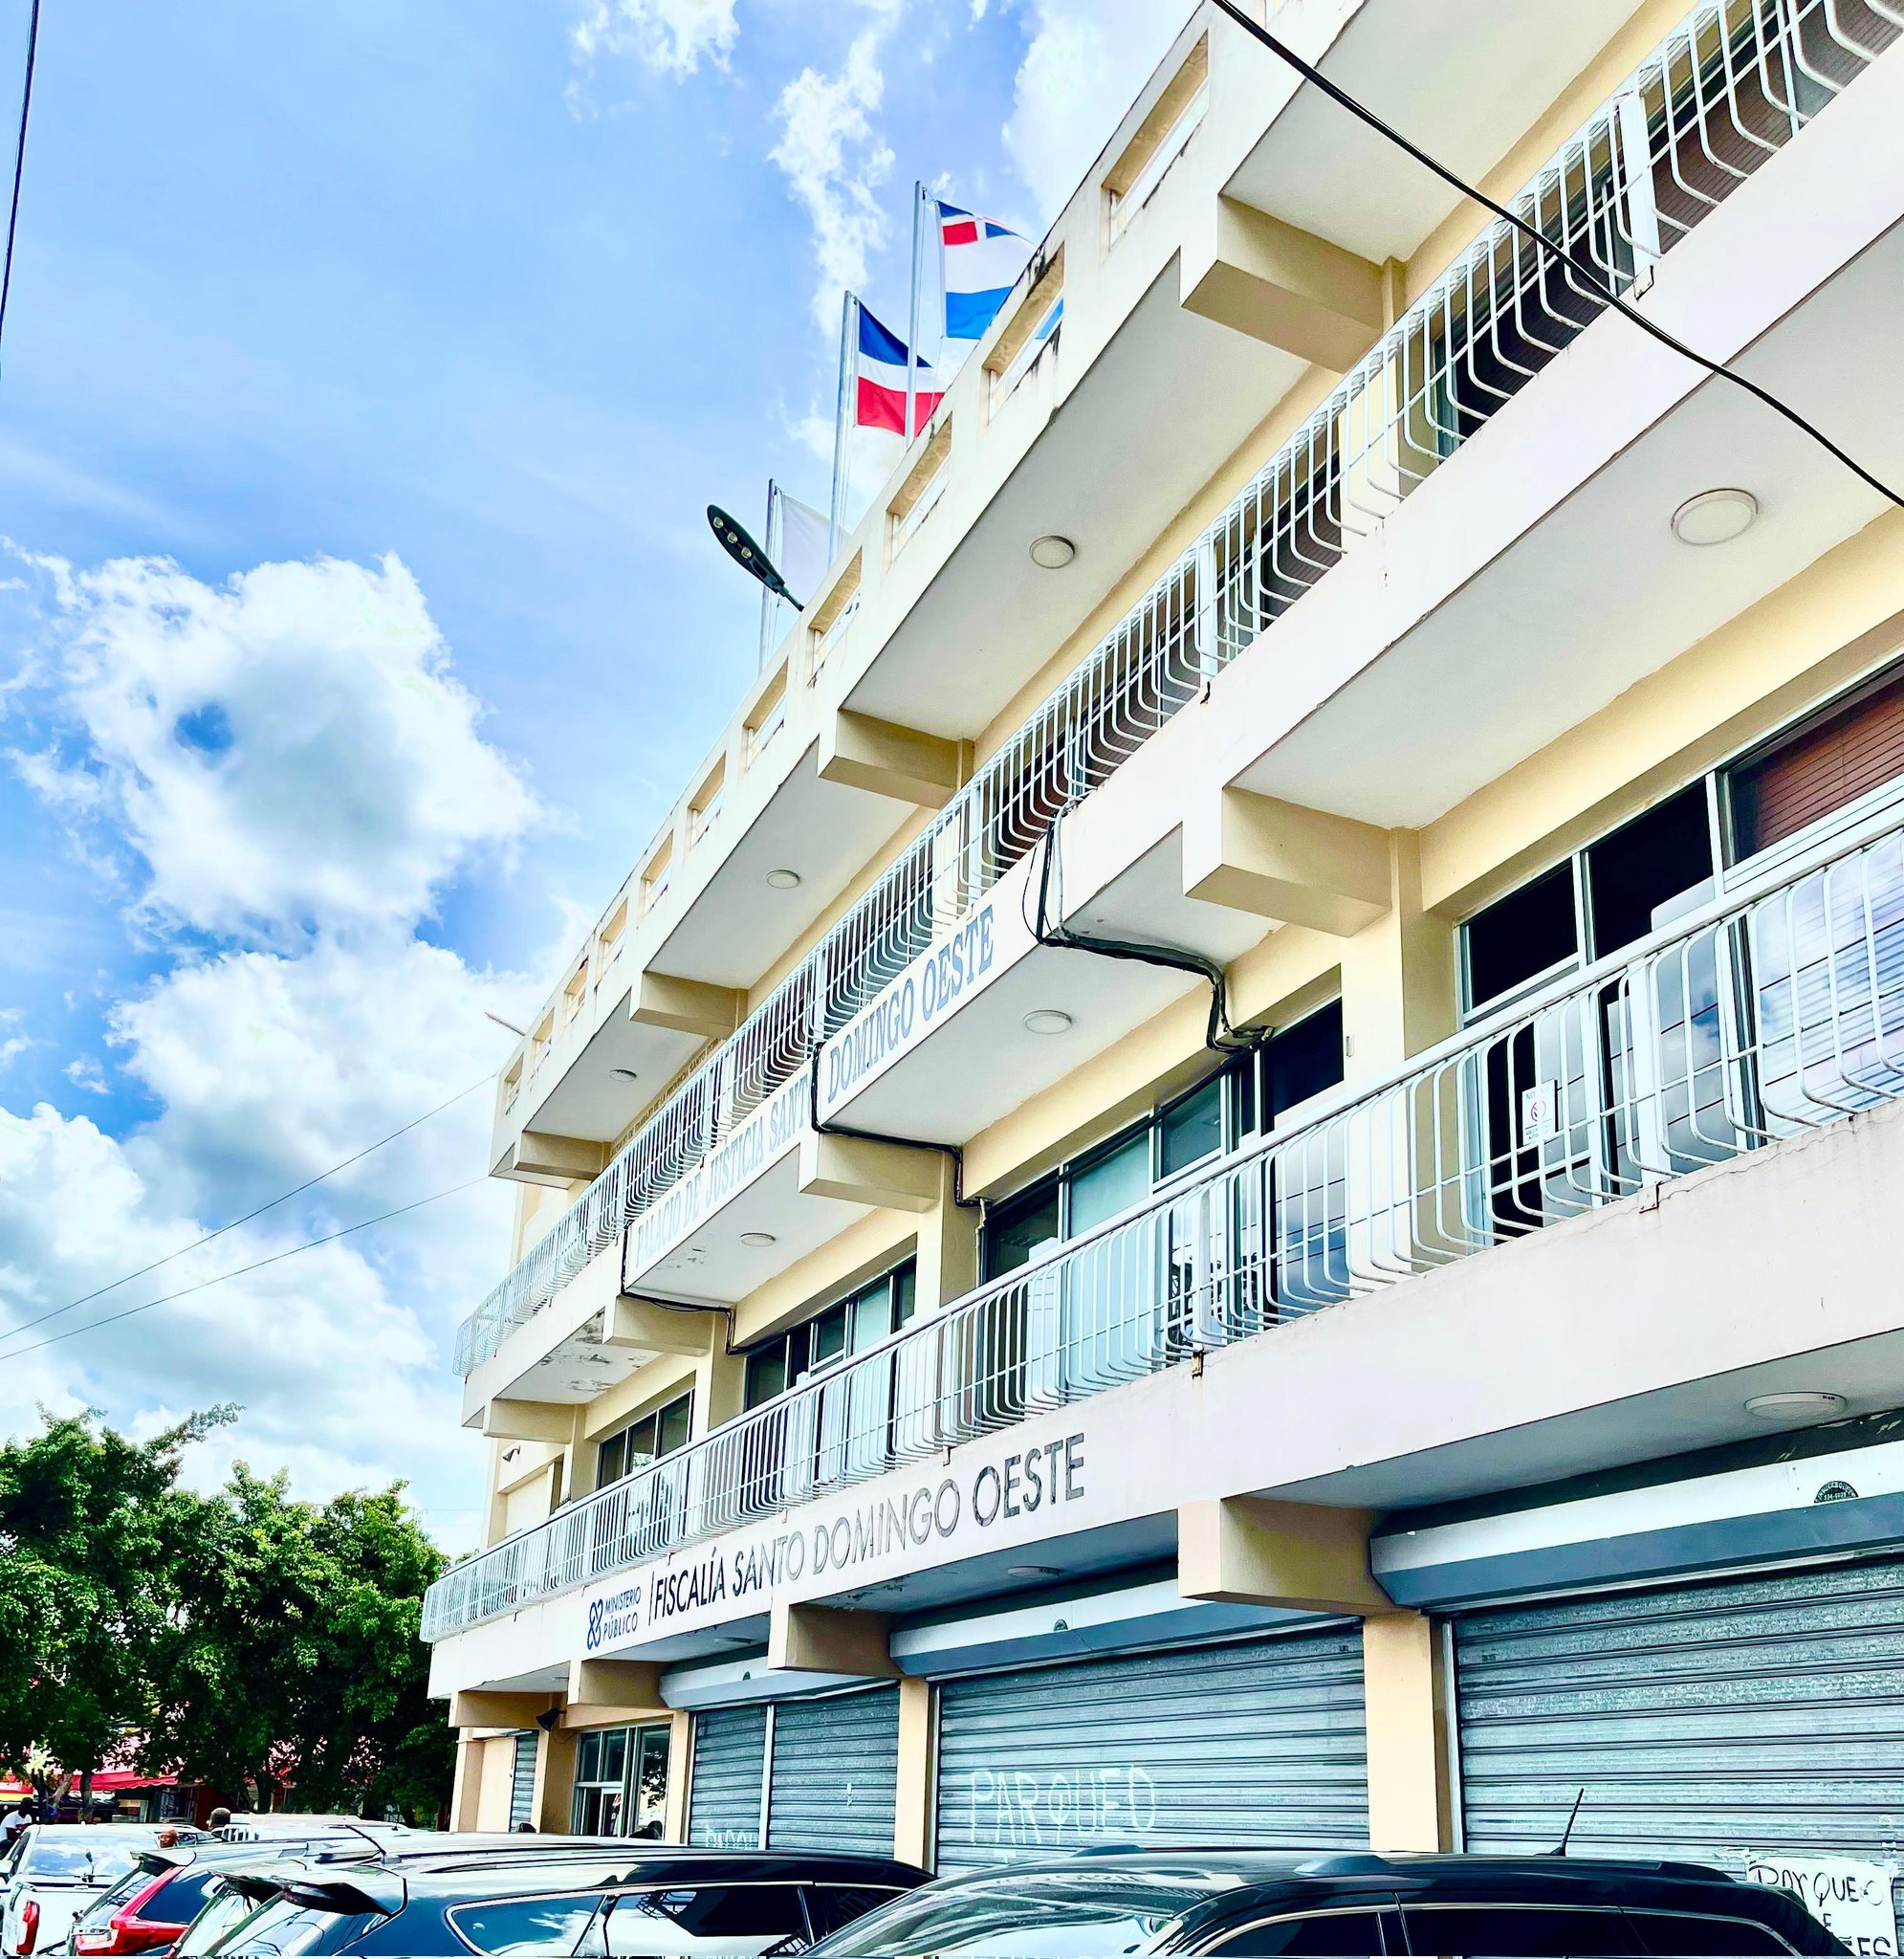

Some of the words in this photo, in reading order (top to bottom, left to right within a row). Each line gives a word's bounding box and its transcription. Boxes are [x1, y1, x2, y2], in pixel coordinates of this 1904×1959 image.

[684, 1173, 701, 1230] DE
[707, 1115, 764, 1209] JUSTICIA
[828, 977, 914, 1104] DOMINGO
[922, 904, 994, 1022] OESTE
[689, 1050, 706, 1072] SANTO
[654, 1547, 726, 1619] FISCALÍA
[733, 1530, 804, 1597] SANTO
[813, 1478, 961, 1575] DOMINGO
[972, 1433, 1084, 1528] OESTE
[603, 1612, 639, 1641] PÚBLICO
[604, 1586, 642, 1617] MINISTERIO
[970, 1765, 1157, 1846] PARQUEO
